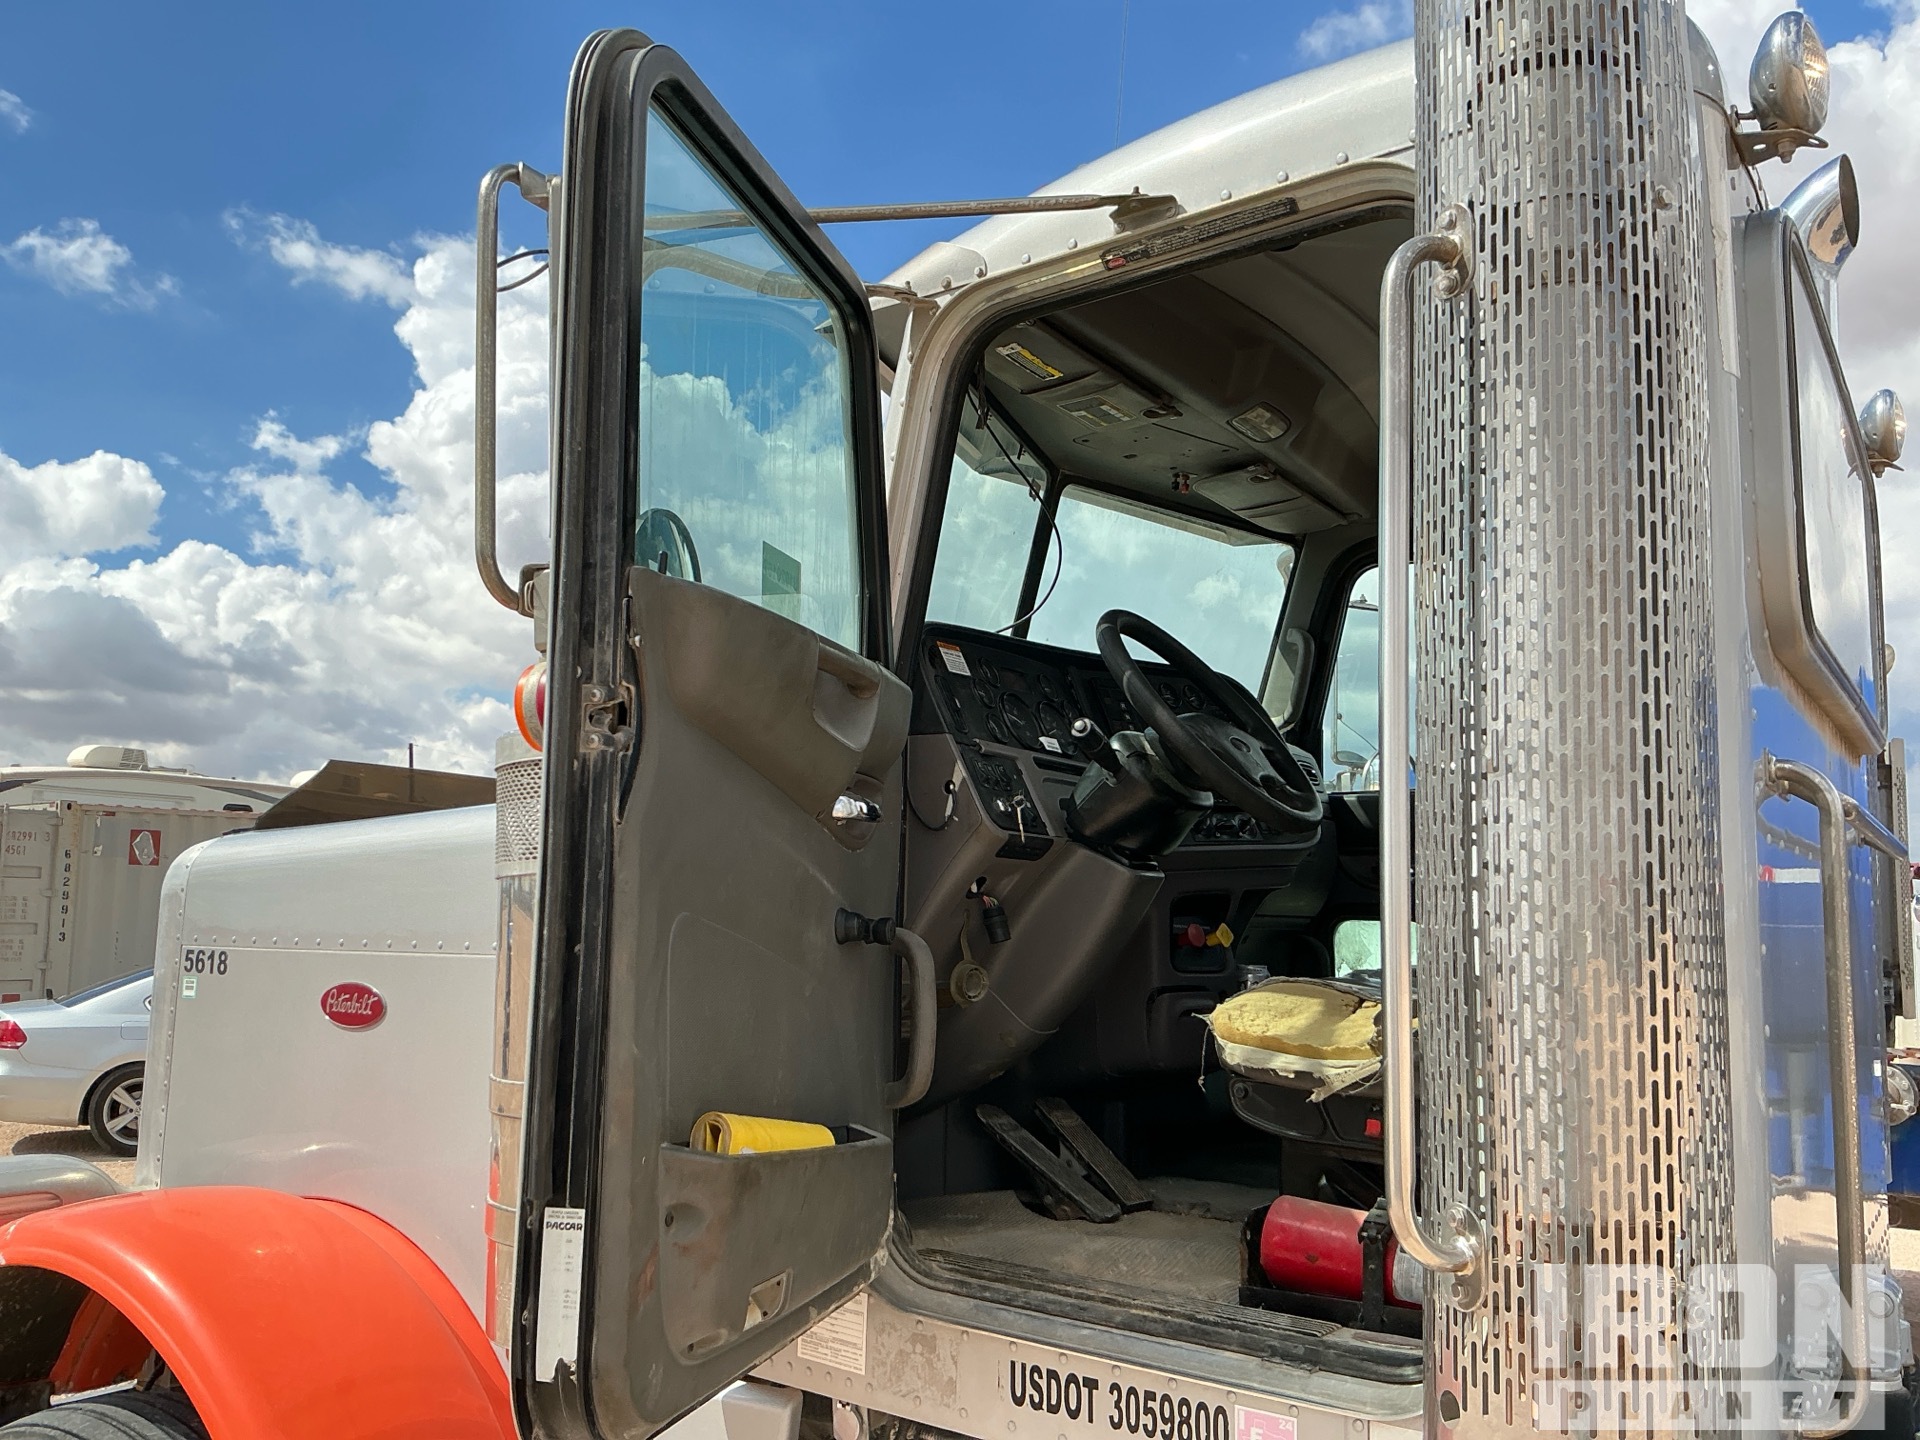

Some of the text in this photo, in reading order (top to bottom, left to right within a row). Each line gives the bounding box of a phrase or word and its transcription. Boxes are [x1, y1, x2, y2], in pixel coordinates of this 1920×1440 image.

[184, 949, 229, 975] 5618
[326, 988, 379, 1015] Peterbilt
[545, 1221, 583, 1231] PACCAR
[1010, 1360, 1230, 1440] USDOT 3059800
